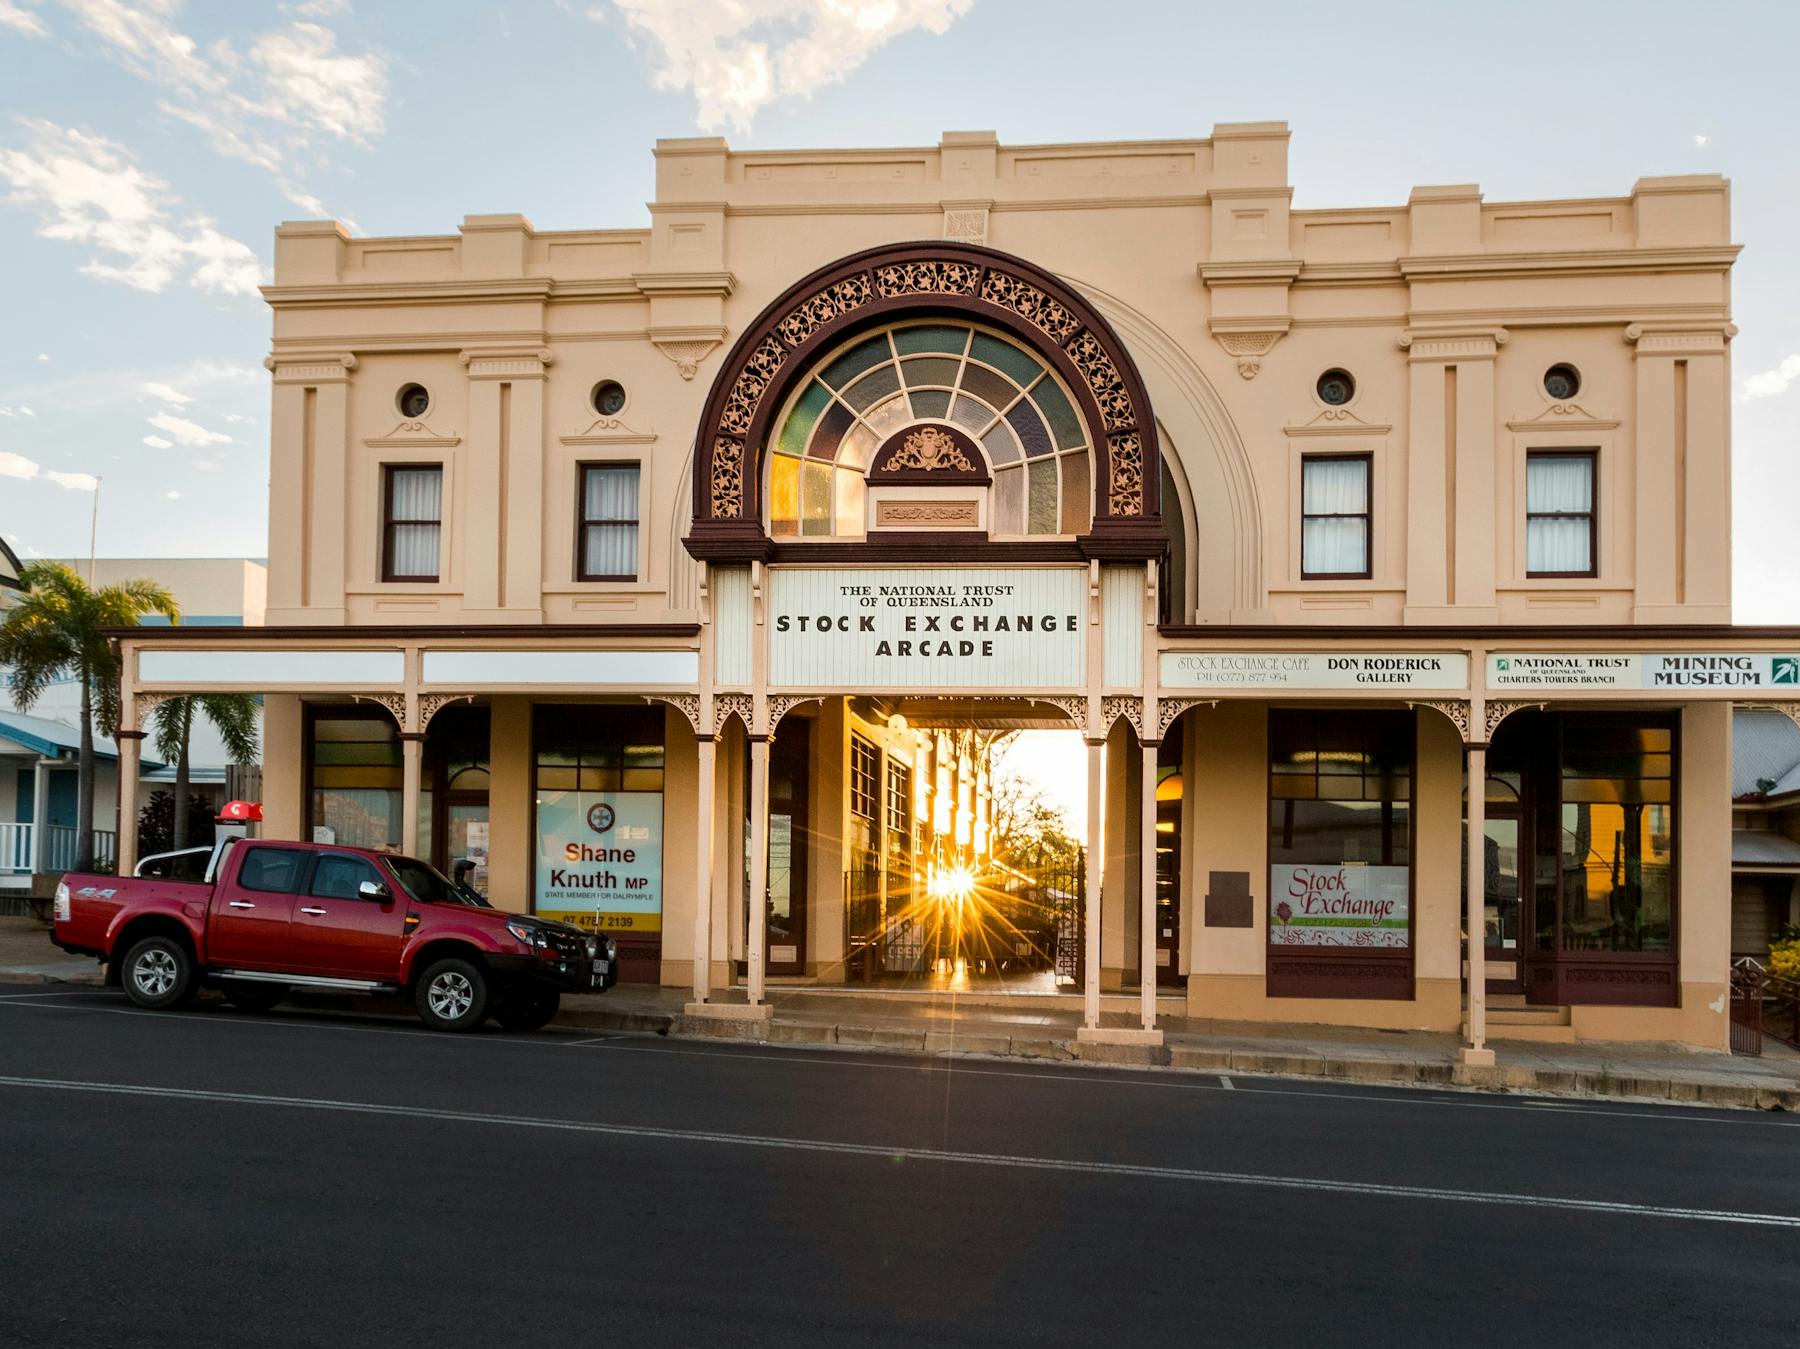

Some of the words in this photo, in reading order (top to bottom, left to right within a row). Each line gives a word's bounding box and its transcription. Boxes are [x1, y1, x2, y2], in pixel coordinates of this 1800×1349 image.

[840, 586, 871, 596] THE
[879, 586, 956, 596] NATIONAL
[963, 586, 1014, 596] TRUST
[860, 597, 878, 607] OF
[887, 597, 994, 607] QUEENSLAND
[777, 615, 876, 632] STOCK
[905, 615, 1078, 632] EXCHANGE
[875, 640, 994, 657] ARCADE
[1178, 657, 1217, 670] STOCK
[1221, 657, 1279, 671] EXCHANGE
[1328, 658, 1359, 670] DON
[1364, 658, 1442, 670] RODERICK
[1514, 658, 1582, 668] NATIONAL
[1587, 658, 1631, 668] TRUST
[1663, 657, 1752, 670] MINING
[1356, 673, 1413, 683] GALLERY
[1655, 672, 1760, 685] MUSEUM
[565, 843, 636, 863] Shane
[551, 869, 617, 889] Knuth
[625, 878, 649, 889] MP
[1288, 868, 1347, 897] Stock
[1300, 892, 1395, 926] Exchange
[563, 915, 576, 924] 07
[608, 917, 633, 927] 2139
[888, 946, 921, 959] OPEN
